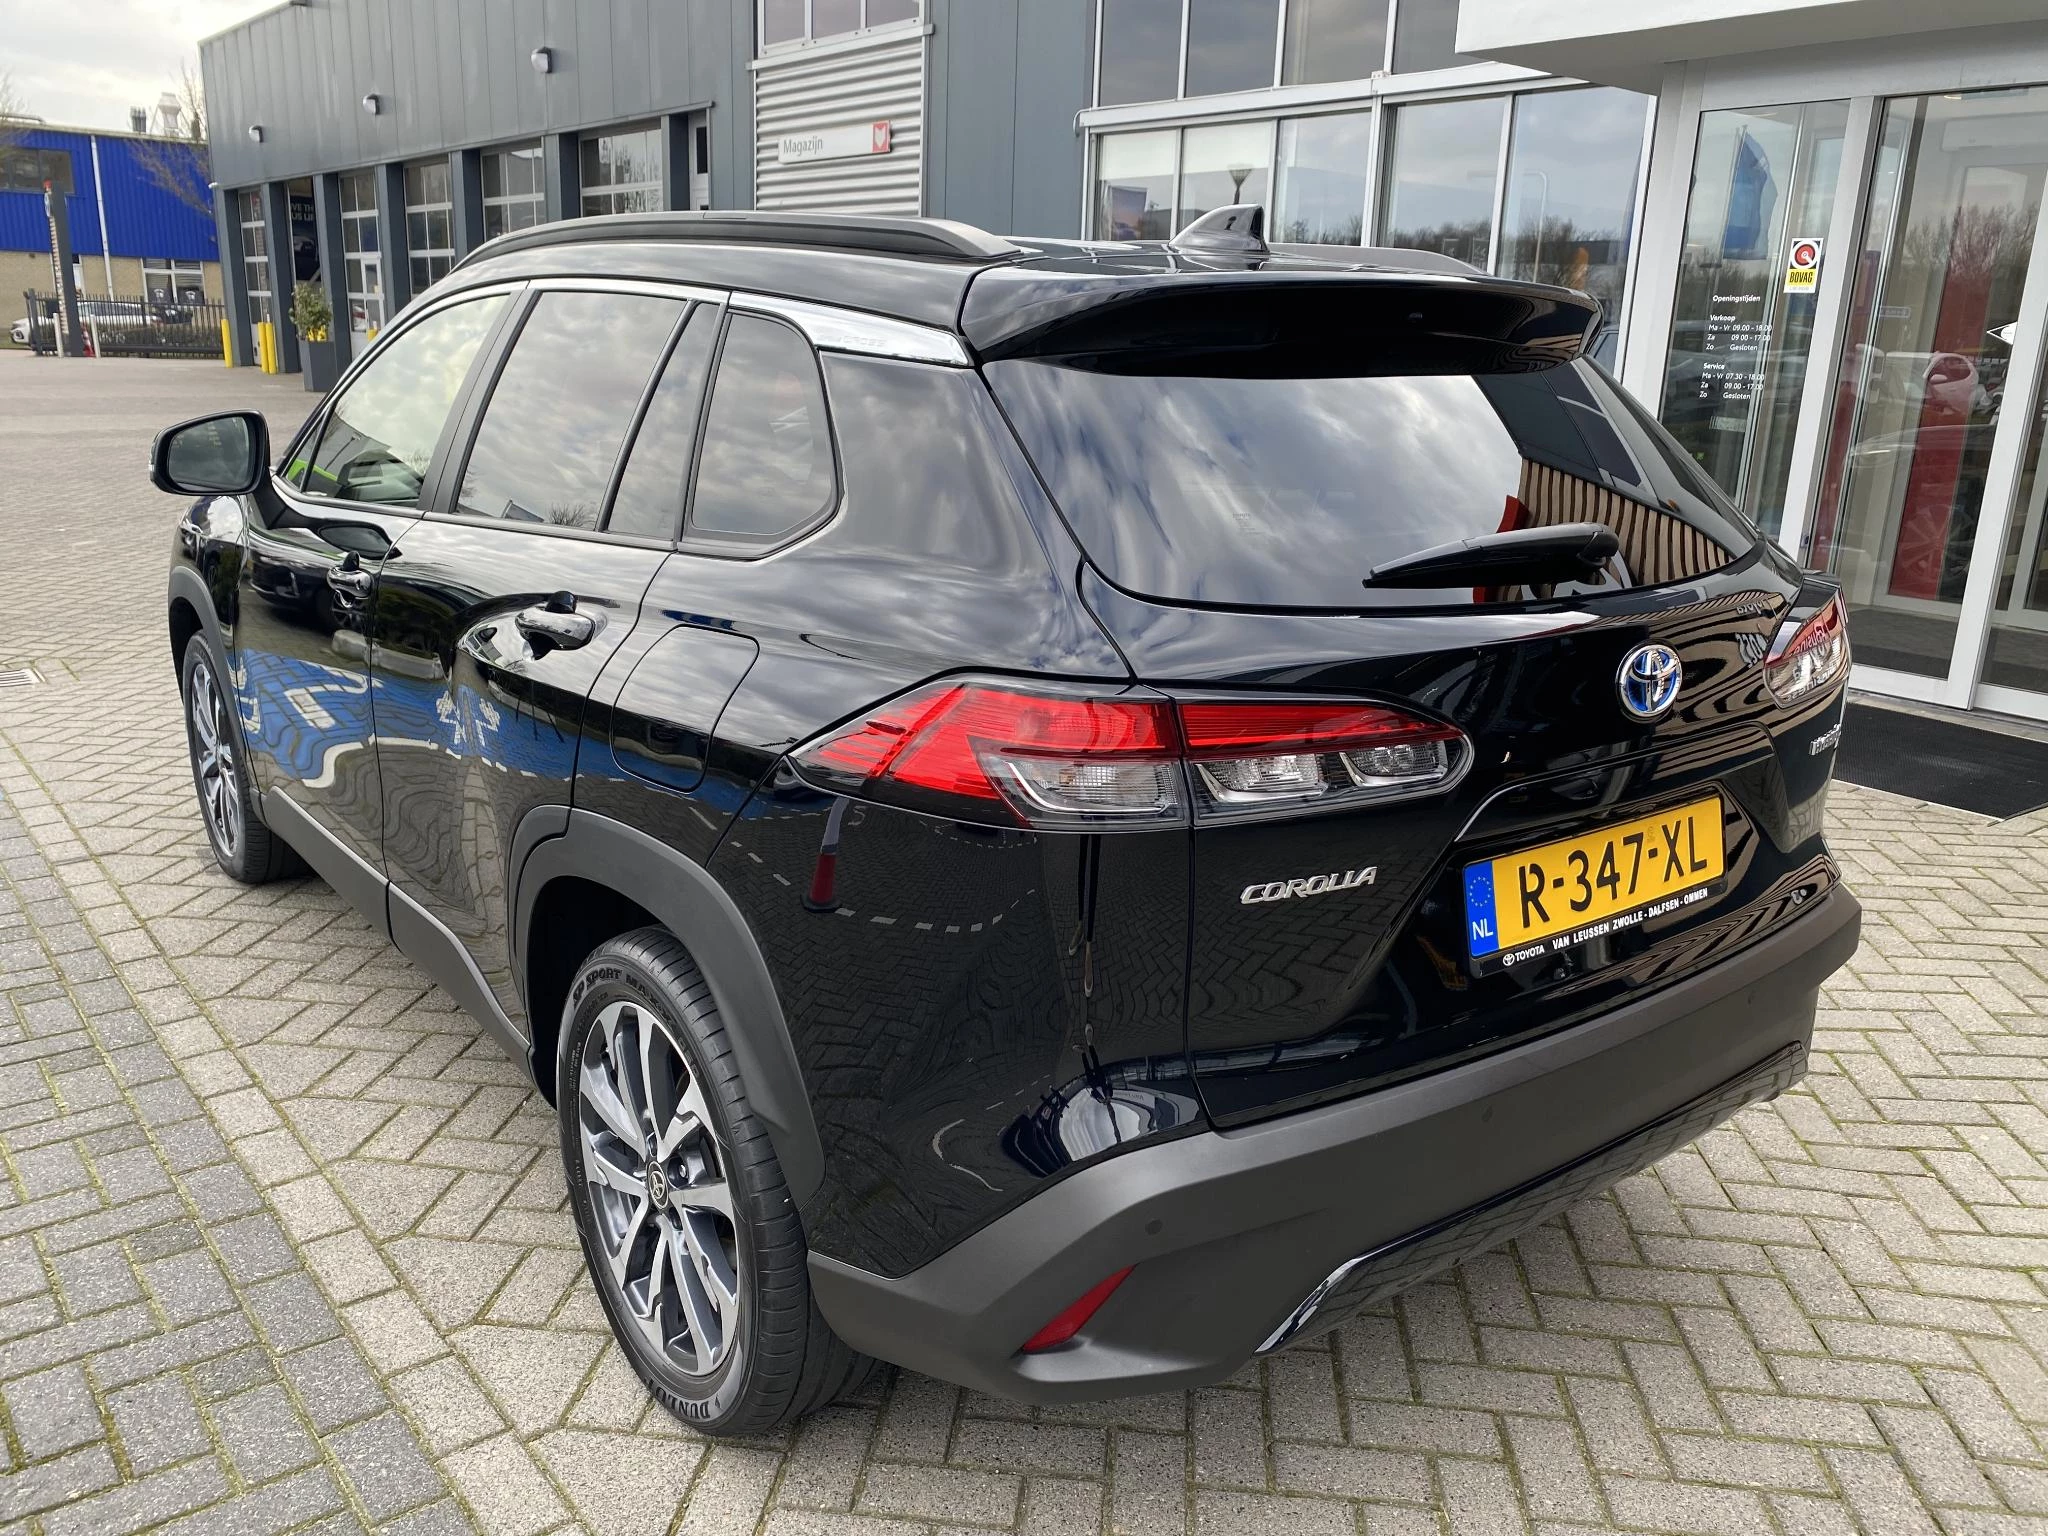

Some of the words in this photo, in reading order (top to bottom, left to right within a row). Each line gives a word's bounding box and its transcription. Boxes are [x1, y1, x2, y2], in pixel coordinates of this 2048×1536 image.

[783, 136, 823, 156] Magazijn
[1789, 271, 1814, 283] BOVAG
[1712, 294, 1761, 303] Openingstijden
[1710, 314, 1736, 322] Verkoop
[1729, 343, 1758, 351] Gesloten
[1703, 362, 1725, 370] Service
[1722, 391, 1751, 400] Gesloten
[1518, 816, 1707, 928] R-347-XL
[1240, 866, 1377, 904] COROLLA
[1472, 919, 1493, 941] NL
[1515, 945, 1545, 962] TOYOTA
[1552, 935, 1569, 950] VAN
[1573, 924, 1609, 943] LEUSSEN
[1612, 911, 1643, 930] ZWOLLE
[1648, 898, 1679, 917] DALFSEN
[1684, 888, 1708, 905] OMMEN
[585, 967, 622, 990] SPORT
